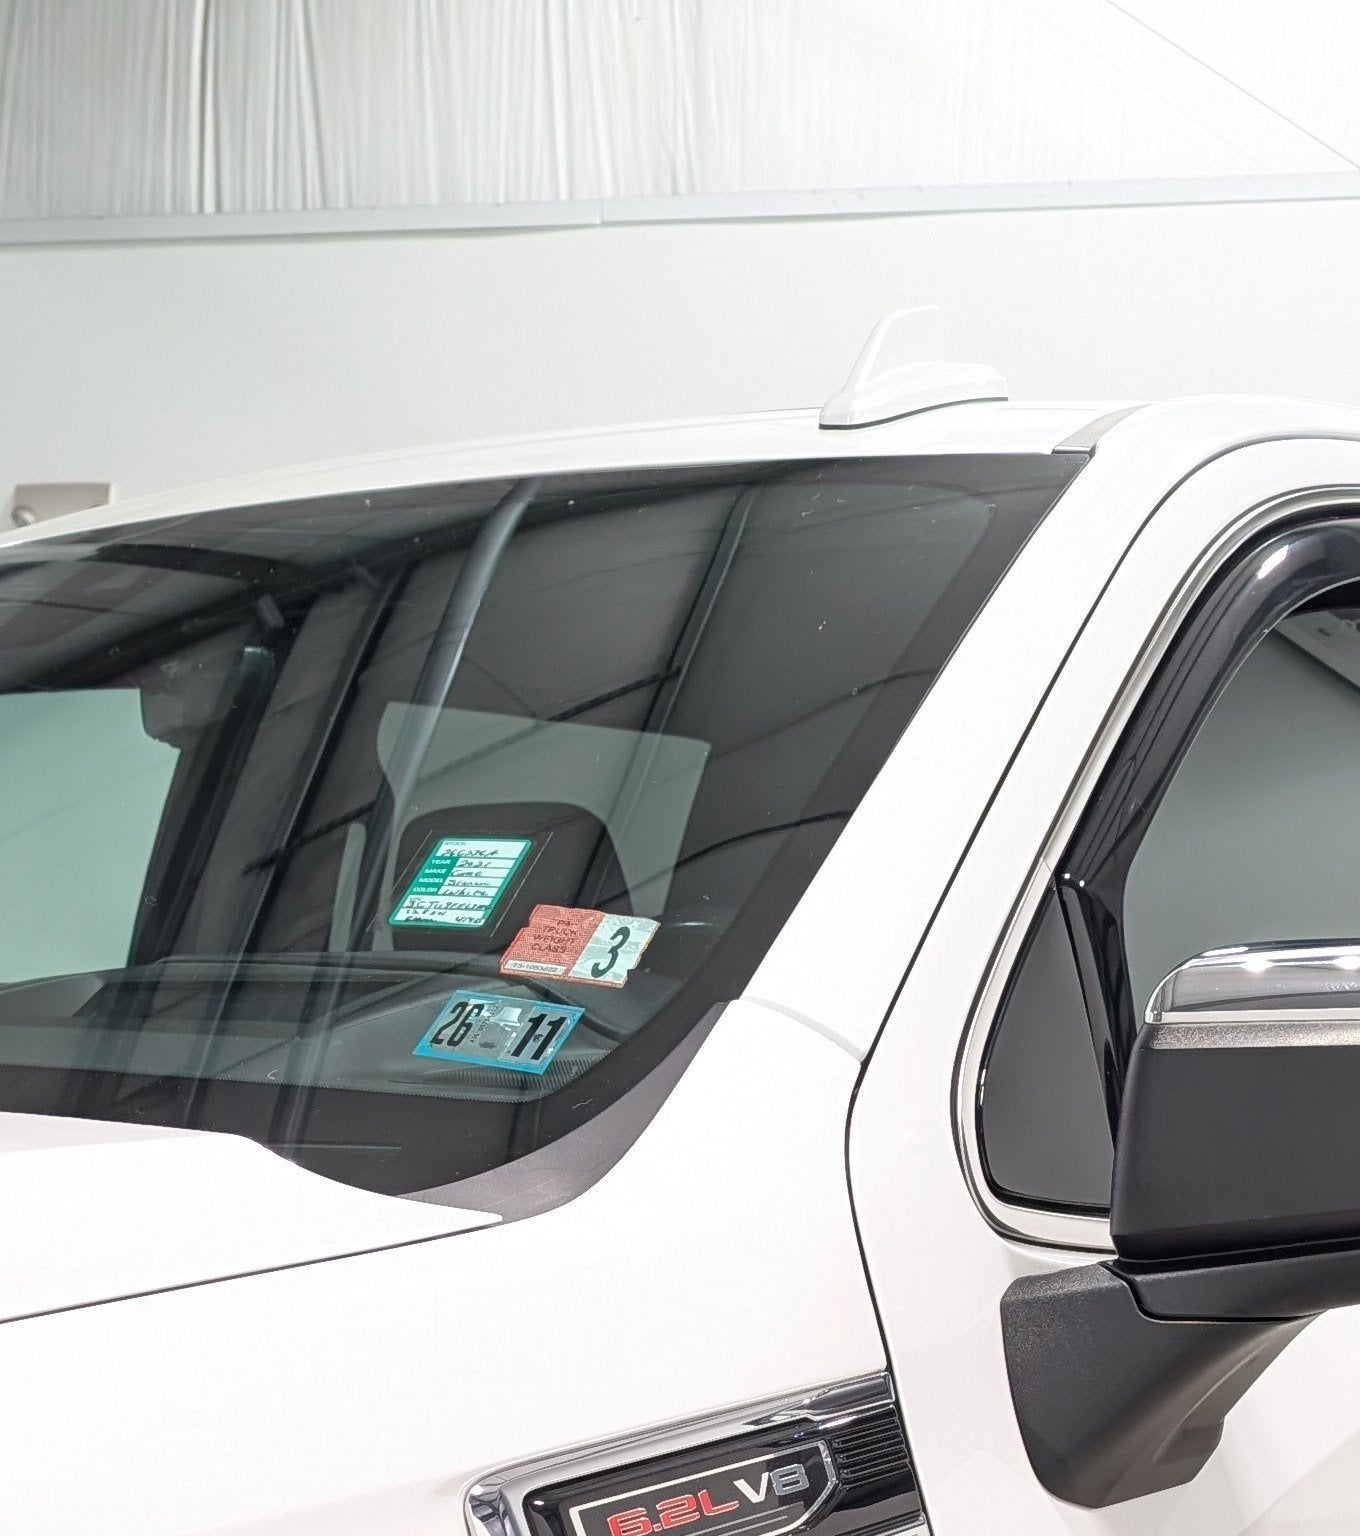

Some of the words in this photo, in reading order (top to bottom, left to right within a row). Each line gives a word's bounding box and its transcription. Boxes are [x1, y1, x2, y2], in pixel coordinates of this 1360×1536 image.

[457, 859, 492, 868] 2021
[533, 934, 575, 945] WEIGHT
[543, 925, 579, 936] TRUCK
[531, 943, 568, 954] CLASS
[590, 926, 631, 979] 3
[429, 1001, 485, 1047] 26
[510, 1012, 568, 1061] 11
[732, 1463, 809, 1505] V8
